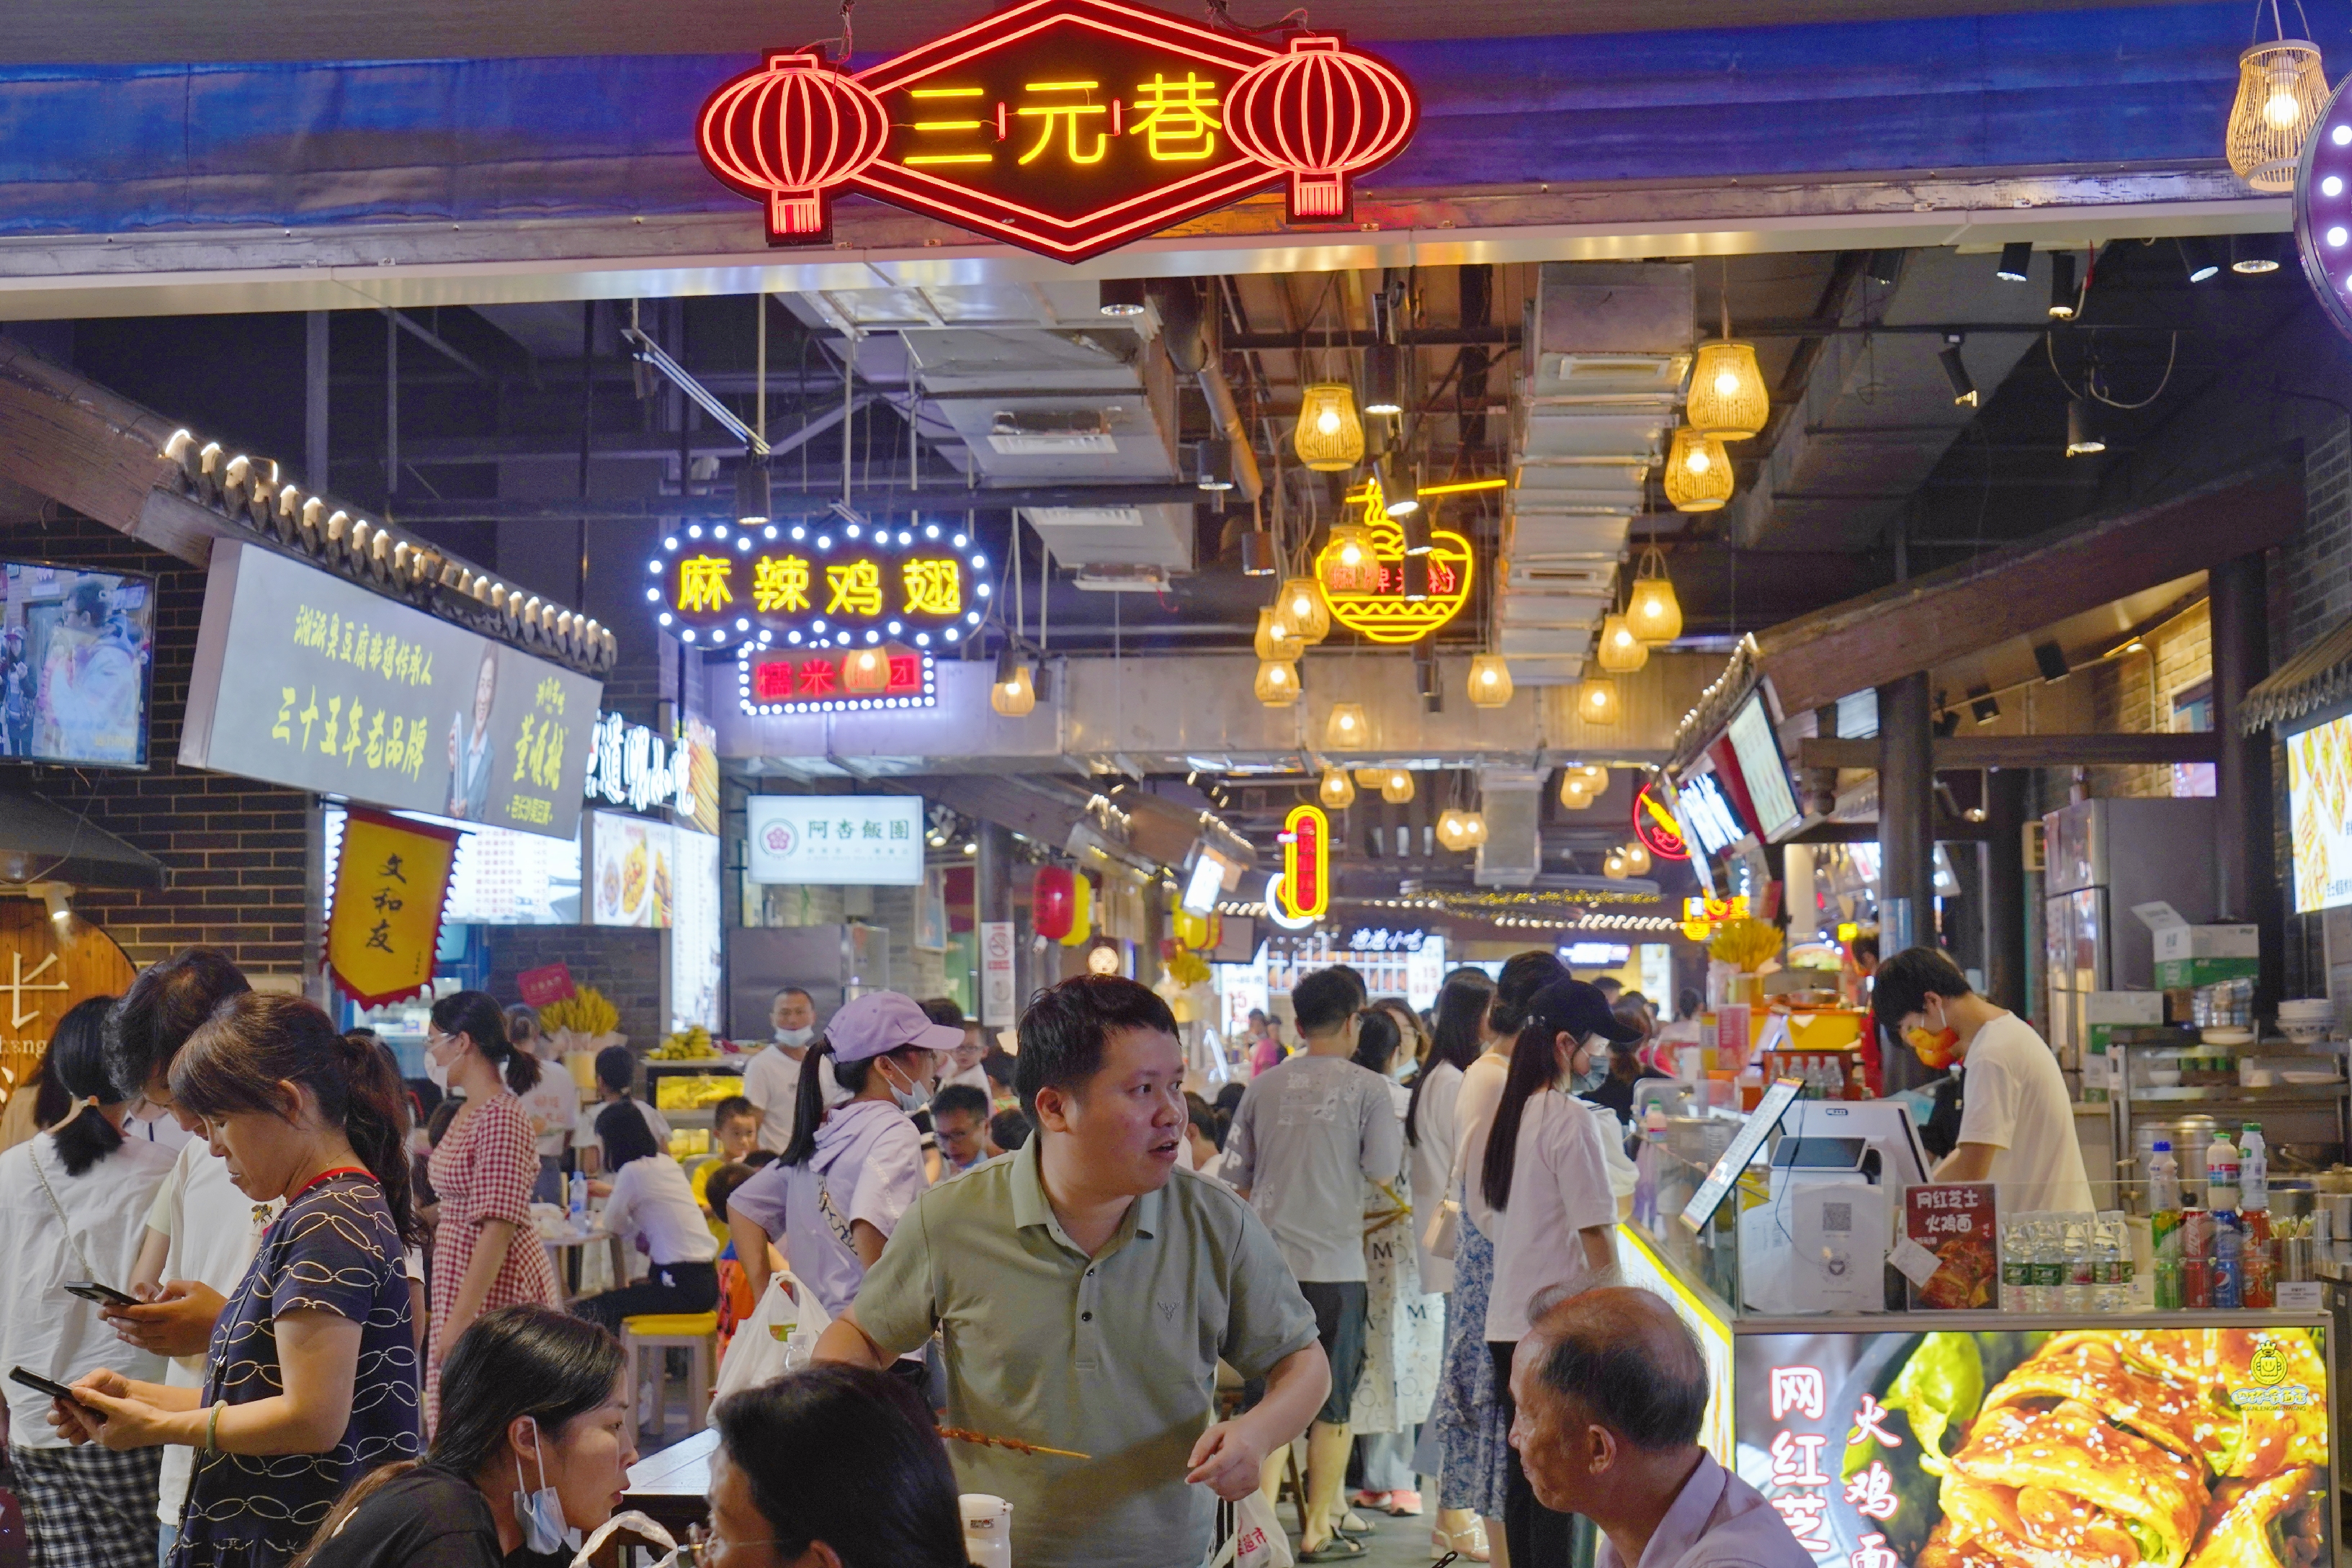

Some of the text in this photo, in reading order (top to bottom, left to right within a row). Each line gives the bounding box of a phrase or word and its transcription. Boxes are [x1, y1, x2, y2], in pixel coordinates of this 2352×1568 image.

[903, 72, 1222, 164] 三元巷
[678, 555, 961, 615] 麻辣鸡翅
[272, 684, 427, 783] 三十五年老品牌
[1916, 1189, 1978, 1209] 网红芝士
[1926, 1214, 1972, 1233] 火鸡面
